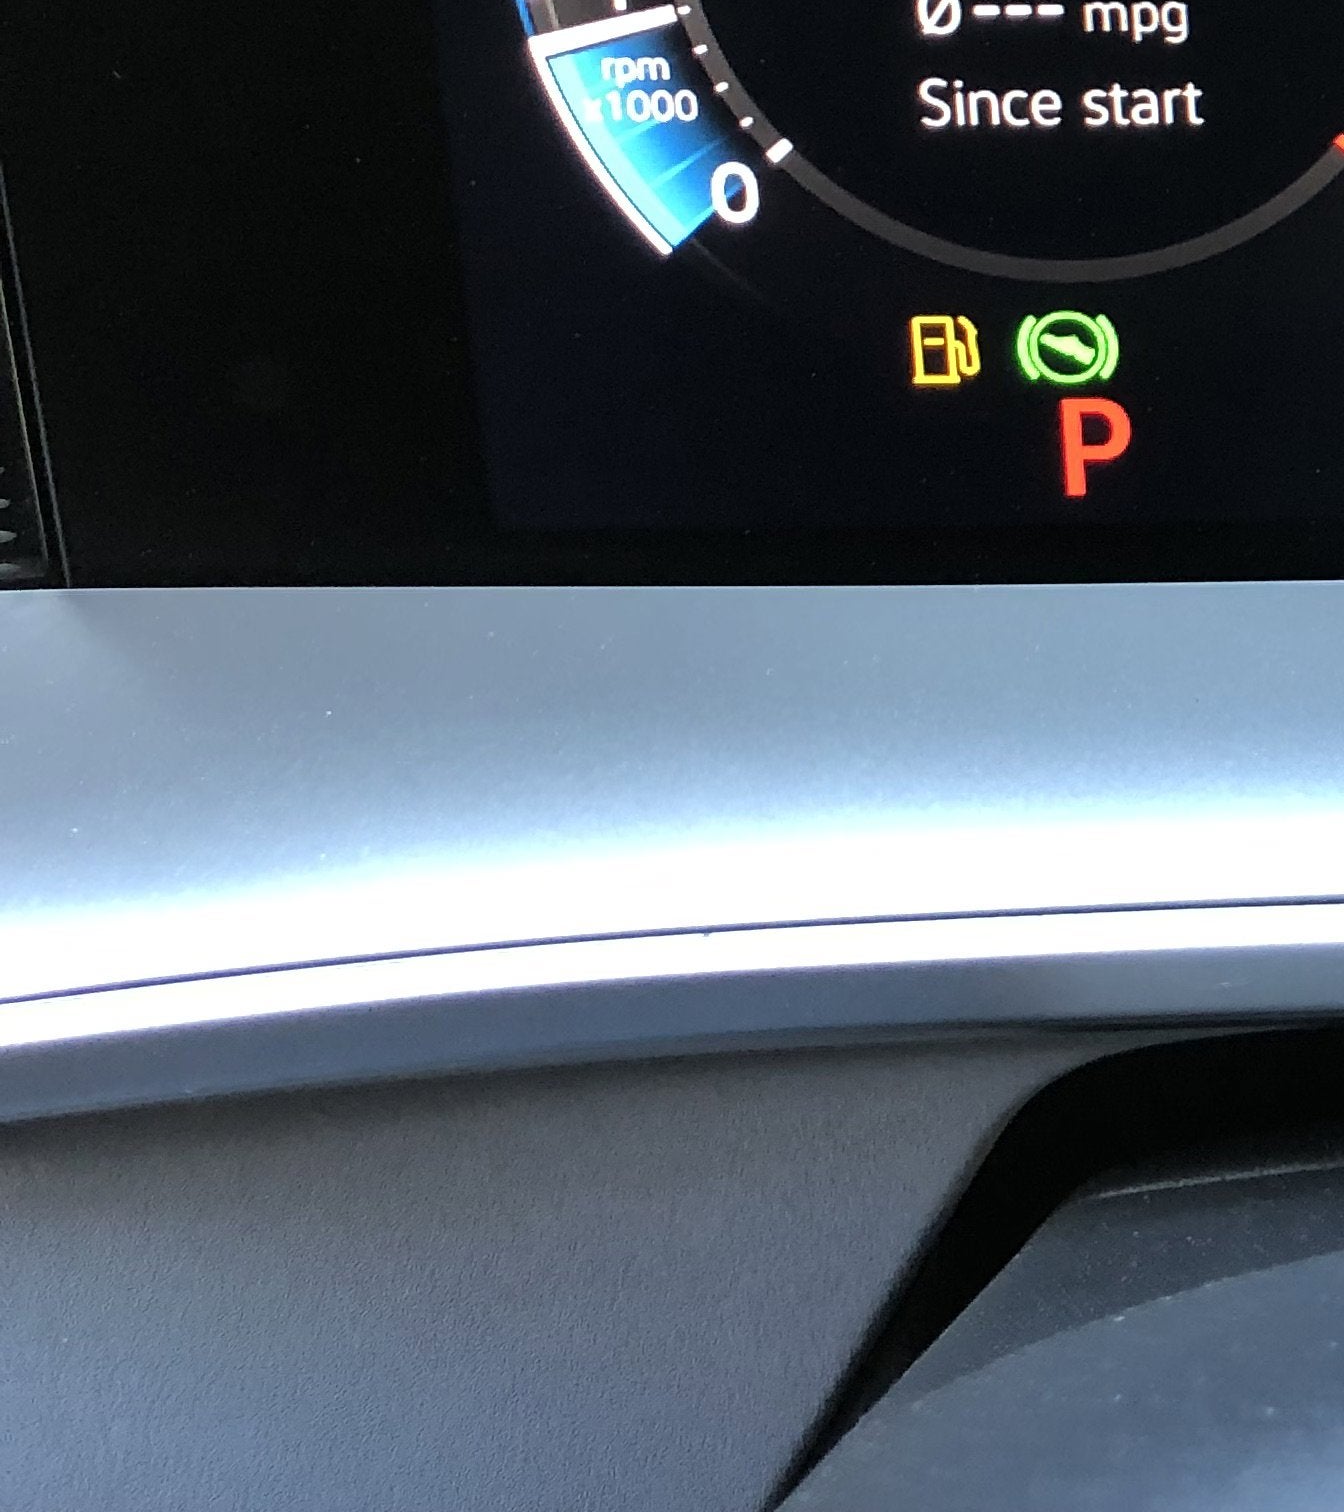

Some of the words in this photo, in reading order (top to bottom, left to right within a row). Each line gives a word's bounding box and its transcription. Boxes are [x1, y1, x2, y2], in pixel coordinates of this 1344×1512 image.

[1083, 1, 1189, 43] mpg
[601, 57, 671, 88] rpm
[918, 78, 1062, 128] Since
[1082, 82, 1205, 128] start
[711, 162, 759, 224] 0
[1058, 396, 1133, 498] P
